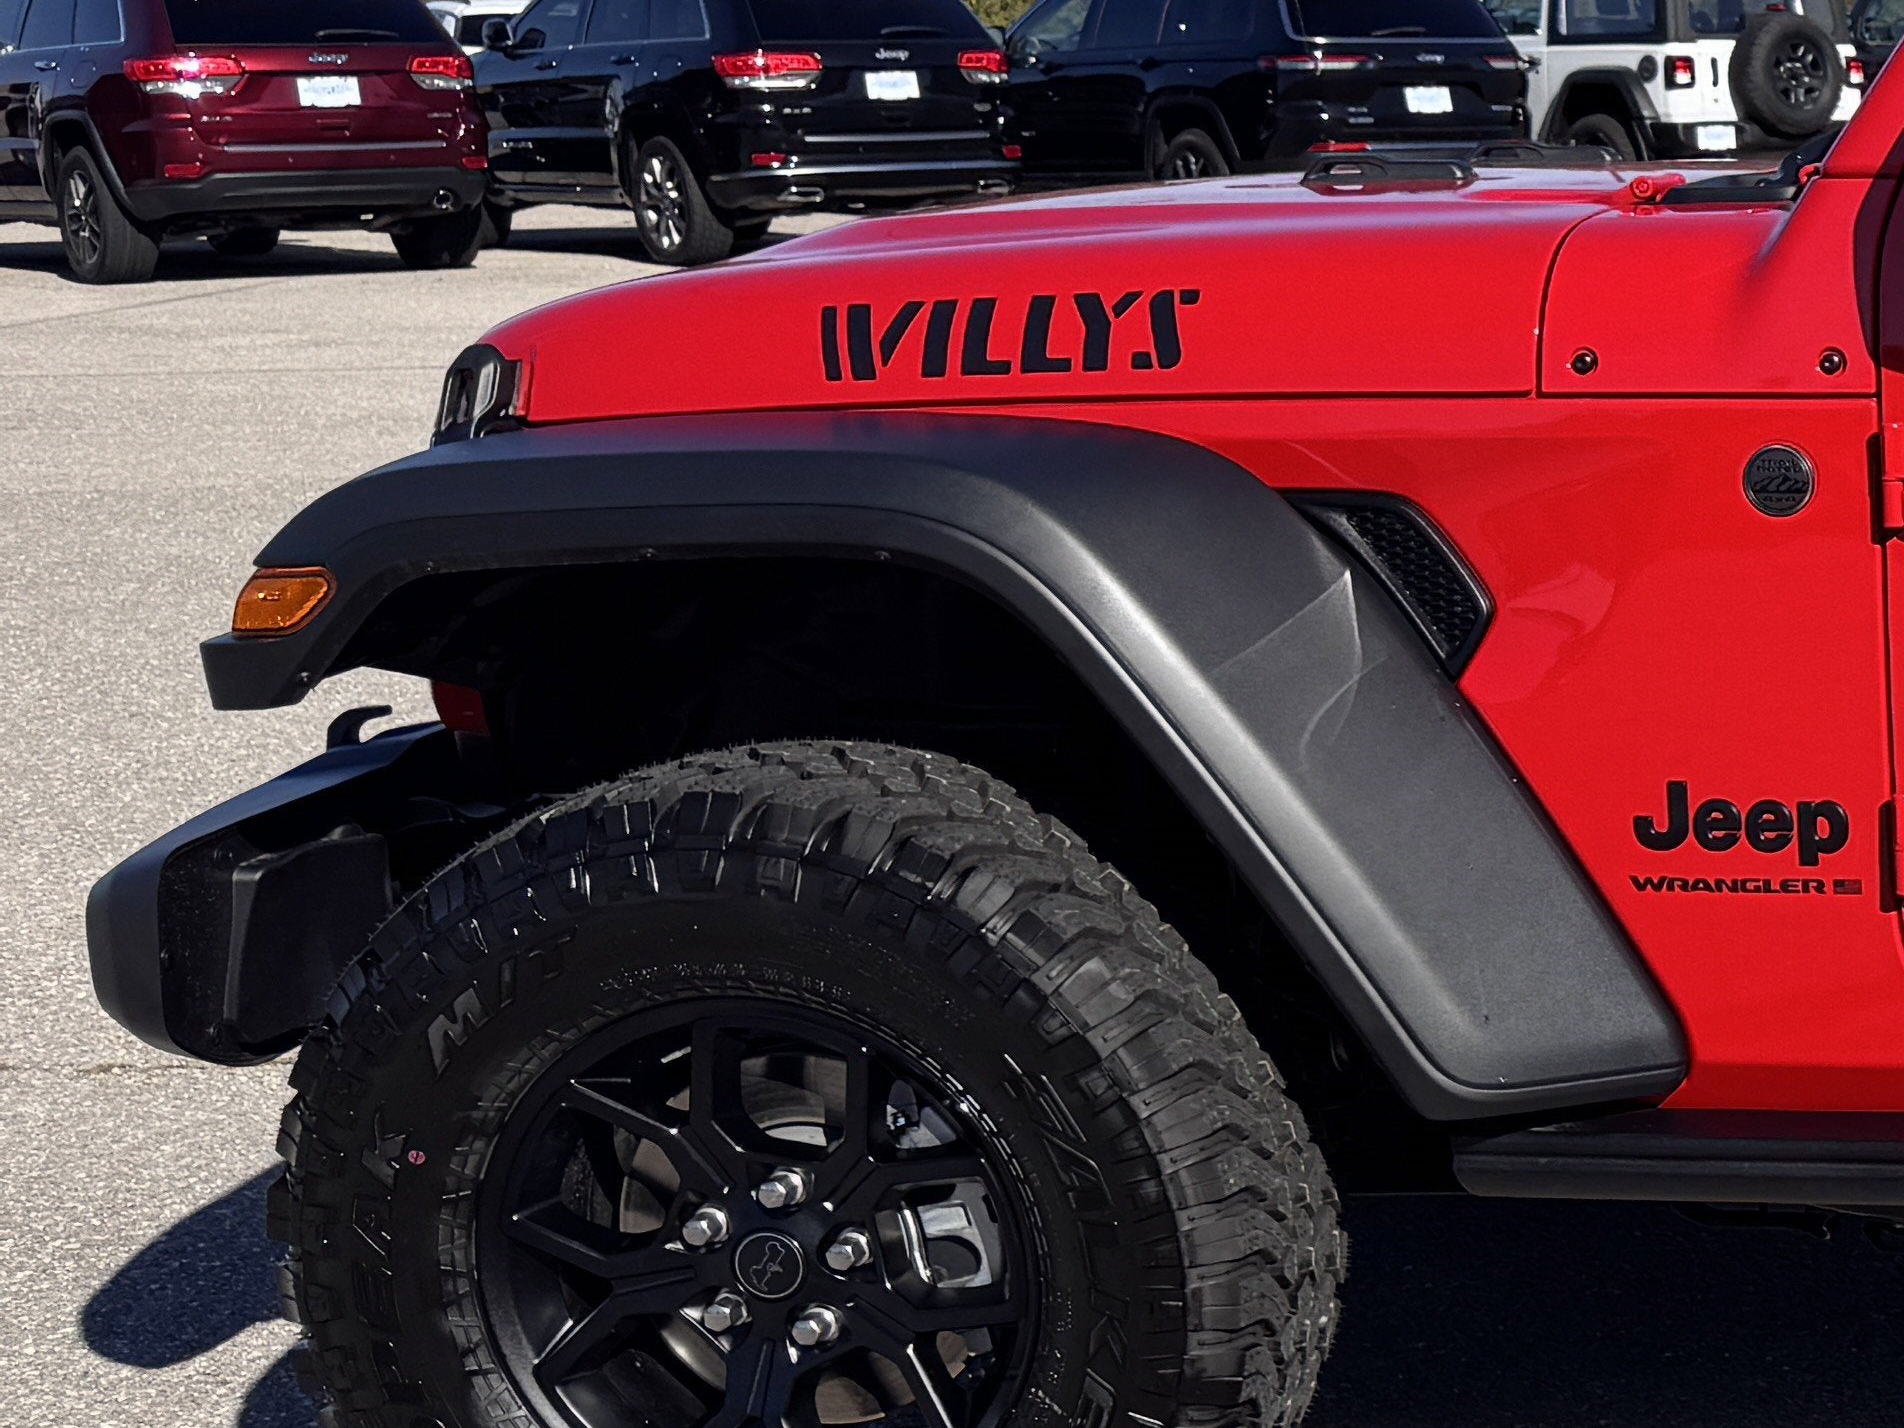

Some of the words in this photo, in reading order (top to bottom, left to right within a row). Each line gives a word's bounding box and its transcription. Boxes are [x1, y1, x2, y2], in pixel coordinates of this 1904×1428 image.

[821, 289, 1200, 382] WILLYS
[1632, 779, 1850, 867] Jeep
[1628, 874, 1827, 895] WRANGLER
